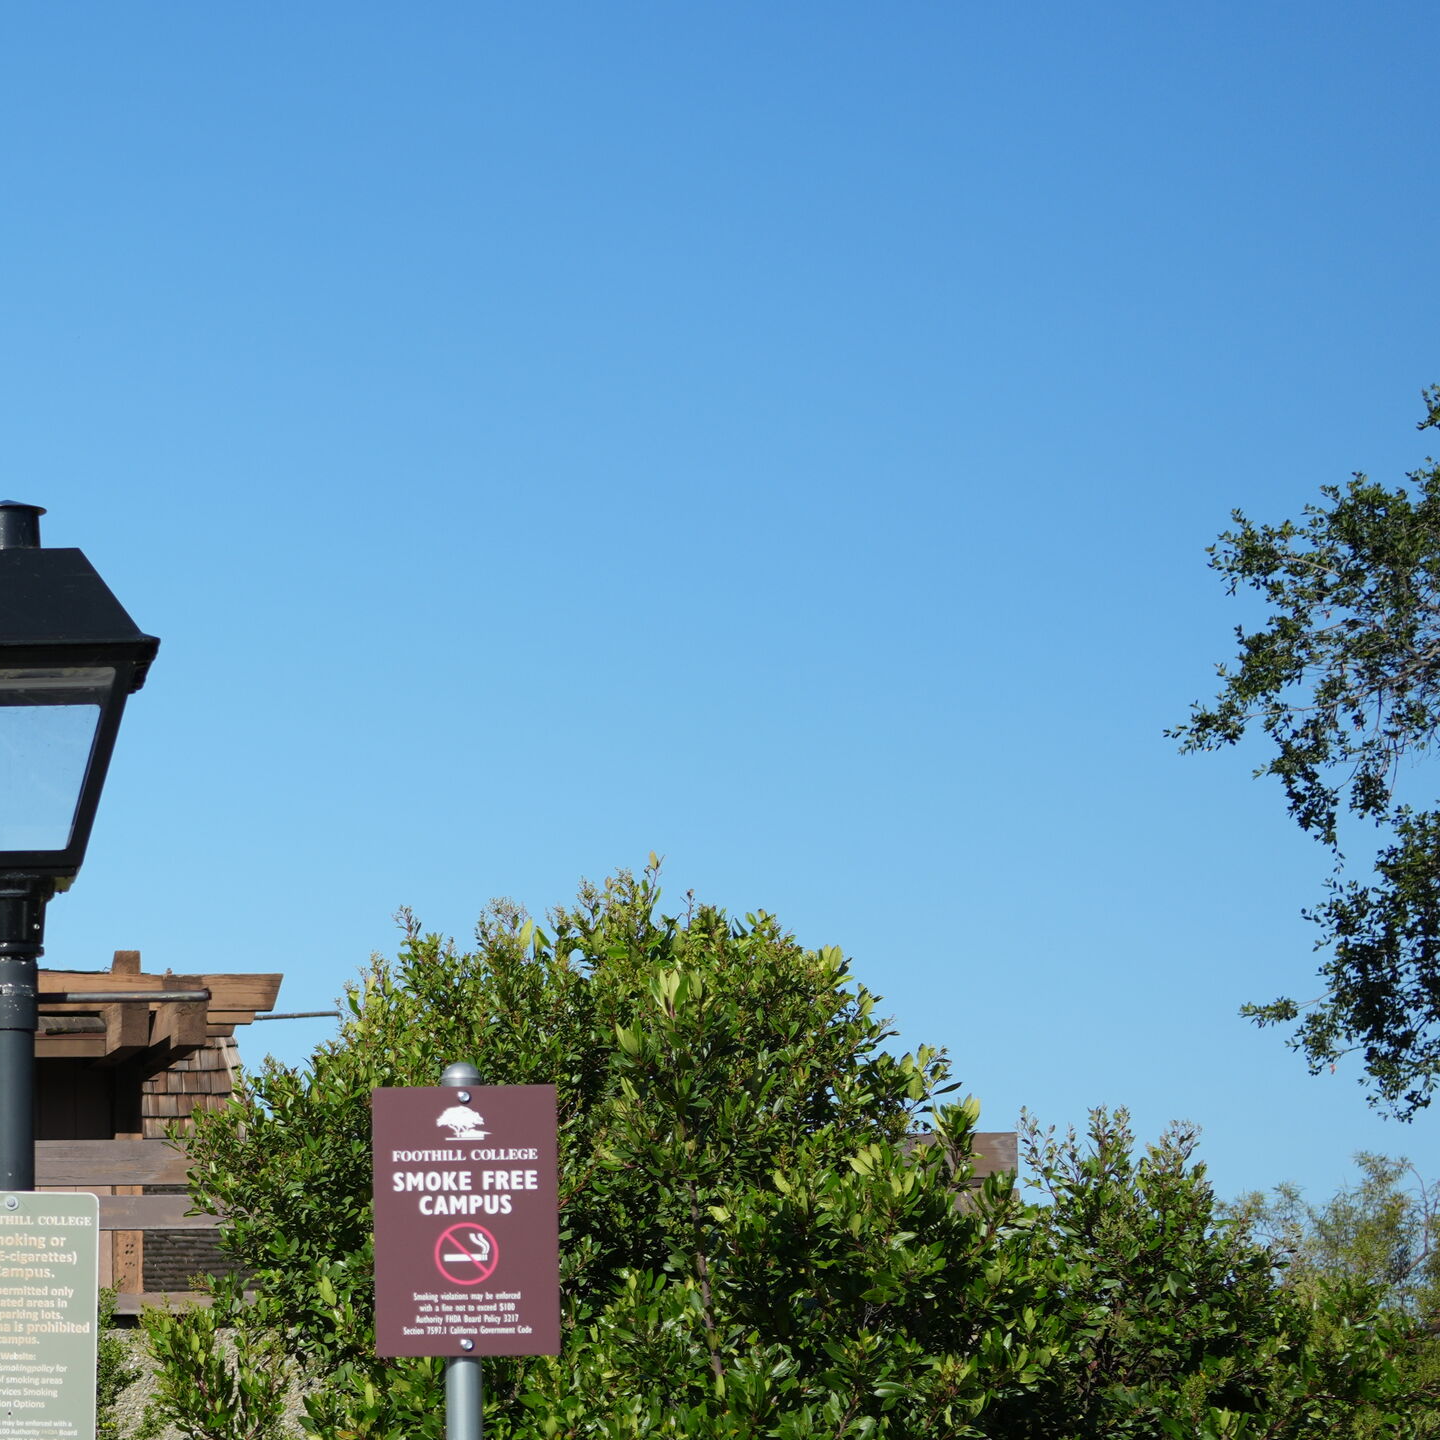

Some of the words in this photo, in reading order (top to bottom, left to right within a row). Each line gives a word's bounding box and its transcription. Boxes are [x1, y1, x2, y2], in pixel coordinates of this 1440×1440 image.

[392, 1149, 466, 1162] FOOTHILL
[470, 1148, 539, 1160] COLLEGE
[392, 1171, 472, 1192] SMOKE
[482, 1170, 538, 1190] FREE
[419, 1194, 512, 1215] CAMPUS
[38, 1216, 92, 1226] COLLEGE
[50, 1236, 67, 1247] or
[51, 1286, 74, 1298] only
[413, 1292, 439, 1303] Smoking
[441, 1292, 469, 1301] violations
[470, 1293, 483, 1302] may
[485, 1292, 493, 1300] be
[495, 1291, 521, 1300] enforced
[26, 1299, 55, 1308] areas
[57, 1298, 68, 1308] in
[419, 1303, 433, 1312] with
[441, 1303, 453, 1312] fine
[455, 1304, 466, 1312] not
[468, 1304, 475, 1312] to
[476, 1303, 497, 1312] exceed
[499, 1302, 515, 1312] $100
[41, 1310, 64, 1320] lots.
[416, 1314, 443, 1325] Authority
[445, 1314, 461, 1323] FHDA
[463, 1314, 481, 1323] Board
[483, 1314, 501, 1325] Policy
[503, 1313, 519, 1323] 3217
[14, 1321, 24, 1332] is
[27, 1322, 90, 1335] prohibited
[403, 1326, 424, 1335] Section
[427, 1326, 447, 1335] 7597.1
[450, 1326, 478, 1335] California
[480, 1326, 516, 1334] Government
[517, 1325, 533, 1334] Code
[0, 1351, 37, 1360] Website:
[55, 1364, 68, 1373] for
[6, 1375, 39, 1386] smoking
[40, 1377, 64, 1385] areas
[23, 1387, 58, 1398] Smoking
[13, 1399, 46, 1409] Options
[10, 1428, 40, 1436] Authority
